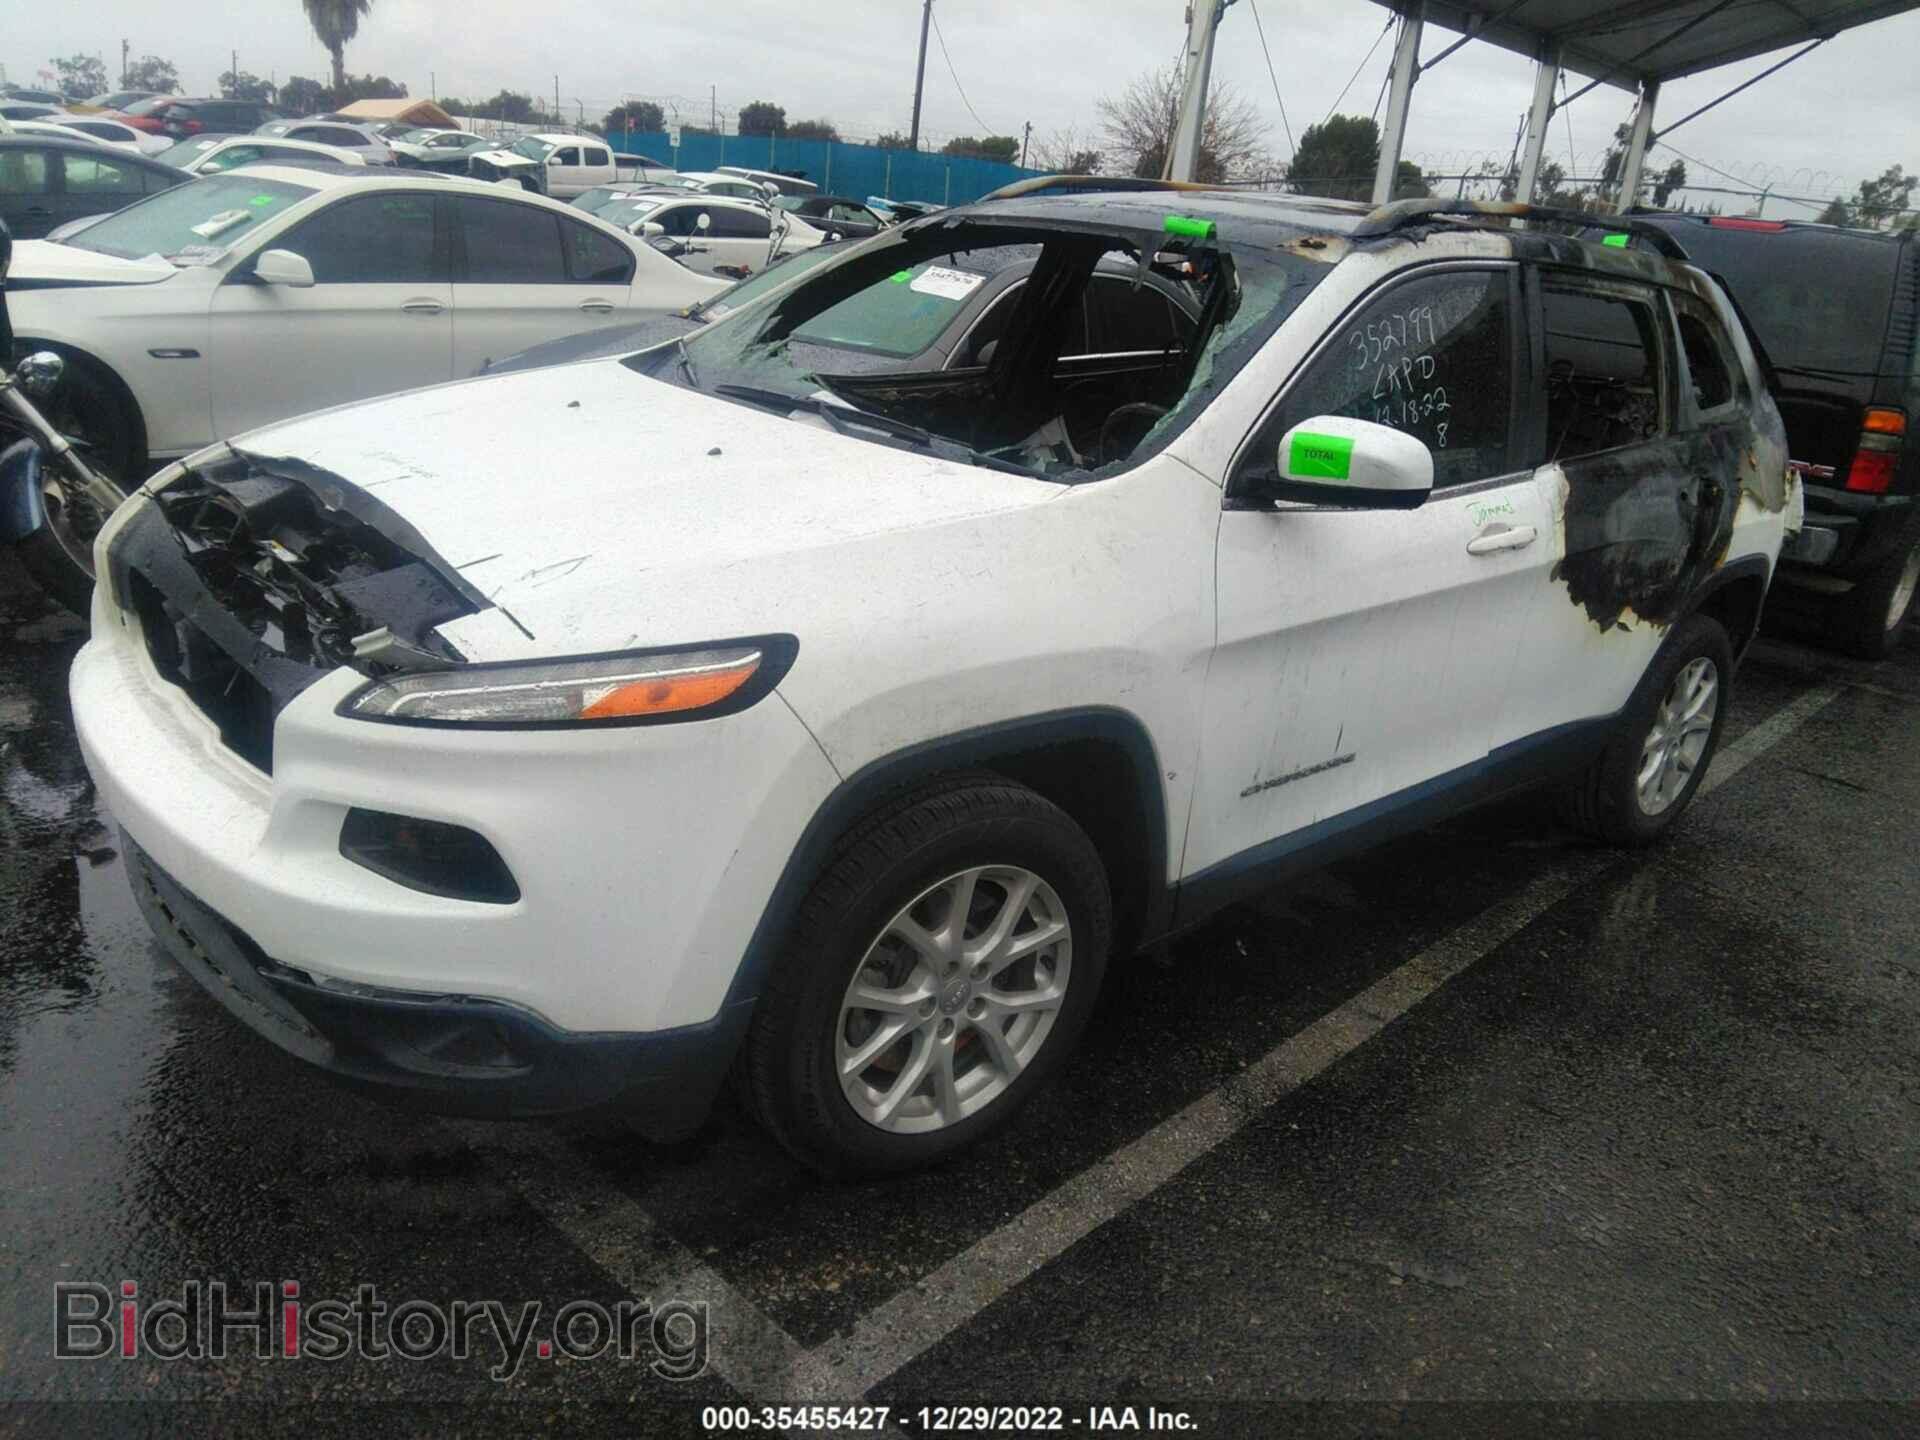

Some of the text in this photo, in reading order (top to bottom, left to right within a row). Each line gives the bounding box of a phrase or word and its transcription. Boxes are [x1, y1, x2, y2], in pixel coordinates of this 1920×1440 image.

[1349, 306, 1436, 370] 352799
[1373, 354, 1435, 399] LAPD
[1437, 422, 1449, 448] 8
[1303, 447, 1335, 461] TOTAL
